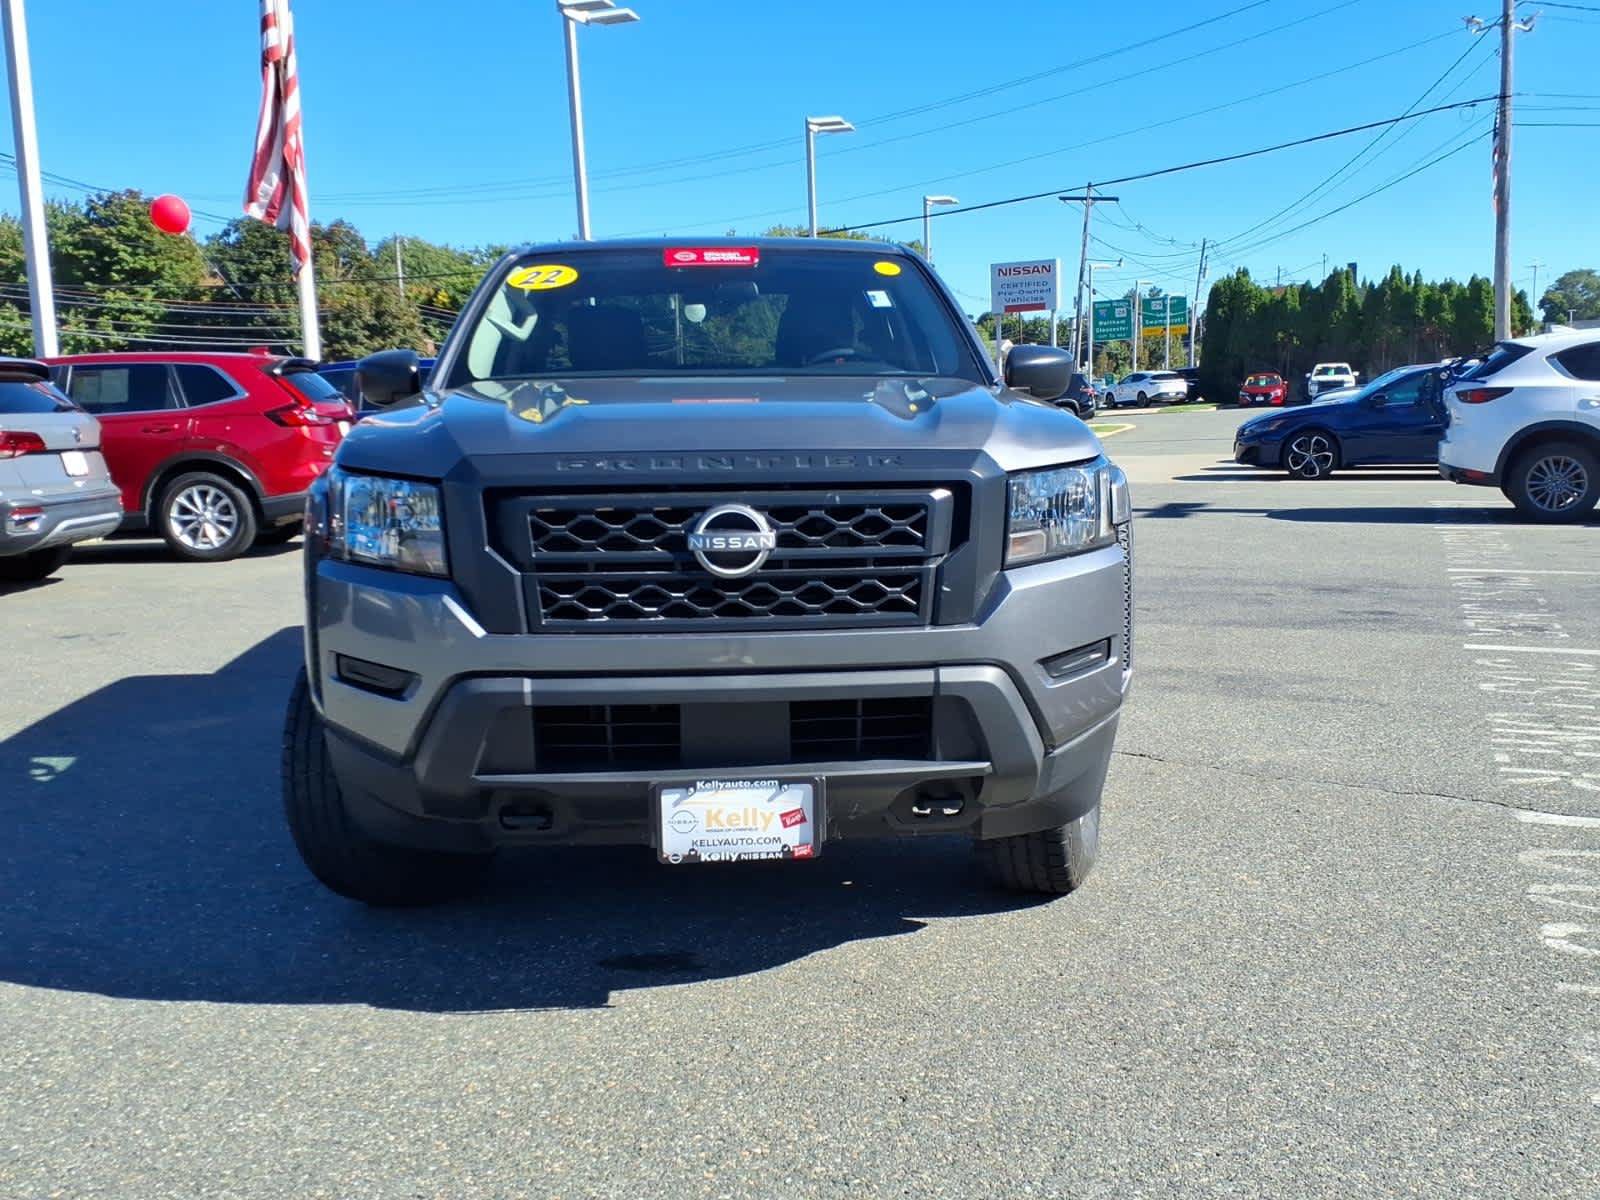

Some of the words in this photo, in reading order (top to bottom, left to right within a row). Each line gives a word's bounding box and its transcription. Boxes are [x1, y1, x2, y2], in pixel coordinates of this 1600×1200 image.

[998, 264, 1052, 277] NISSAN
[518, 270, 563, 286] 22
[1000, 281, 1049, 289] CERTIFIED
[997, 288, 1052, 297] Pre-Owned
[1004, 296, 1045, 304] Vehicles
[1095, 326, 1129, 334] Gloucester
[556, 454, 904, 471] FRONTIER
[689, 536, 774, 549] NISSAN
[696, 780, 779, 791] Kellyauto.com
[705, 808, 775, 833] Kelly
[691, 836, 782, 848] KELLYAUTO.COM
[700, 851, 739, 863] Kelly
[740, 851, 784, 861] NISSAN
